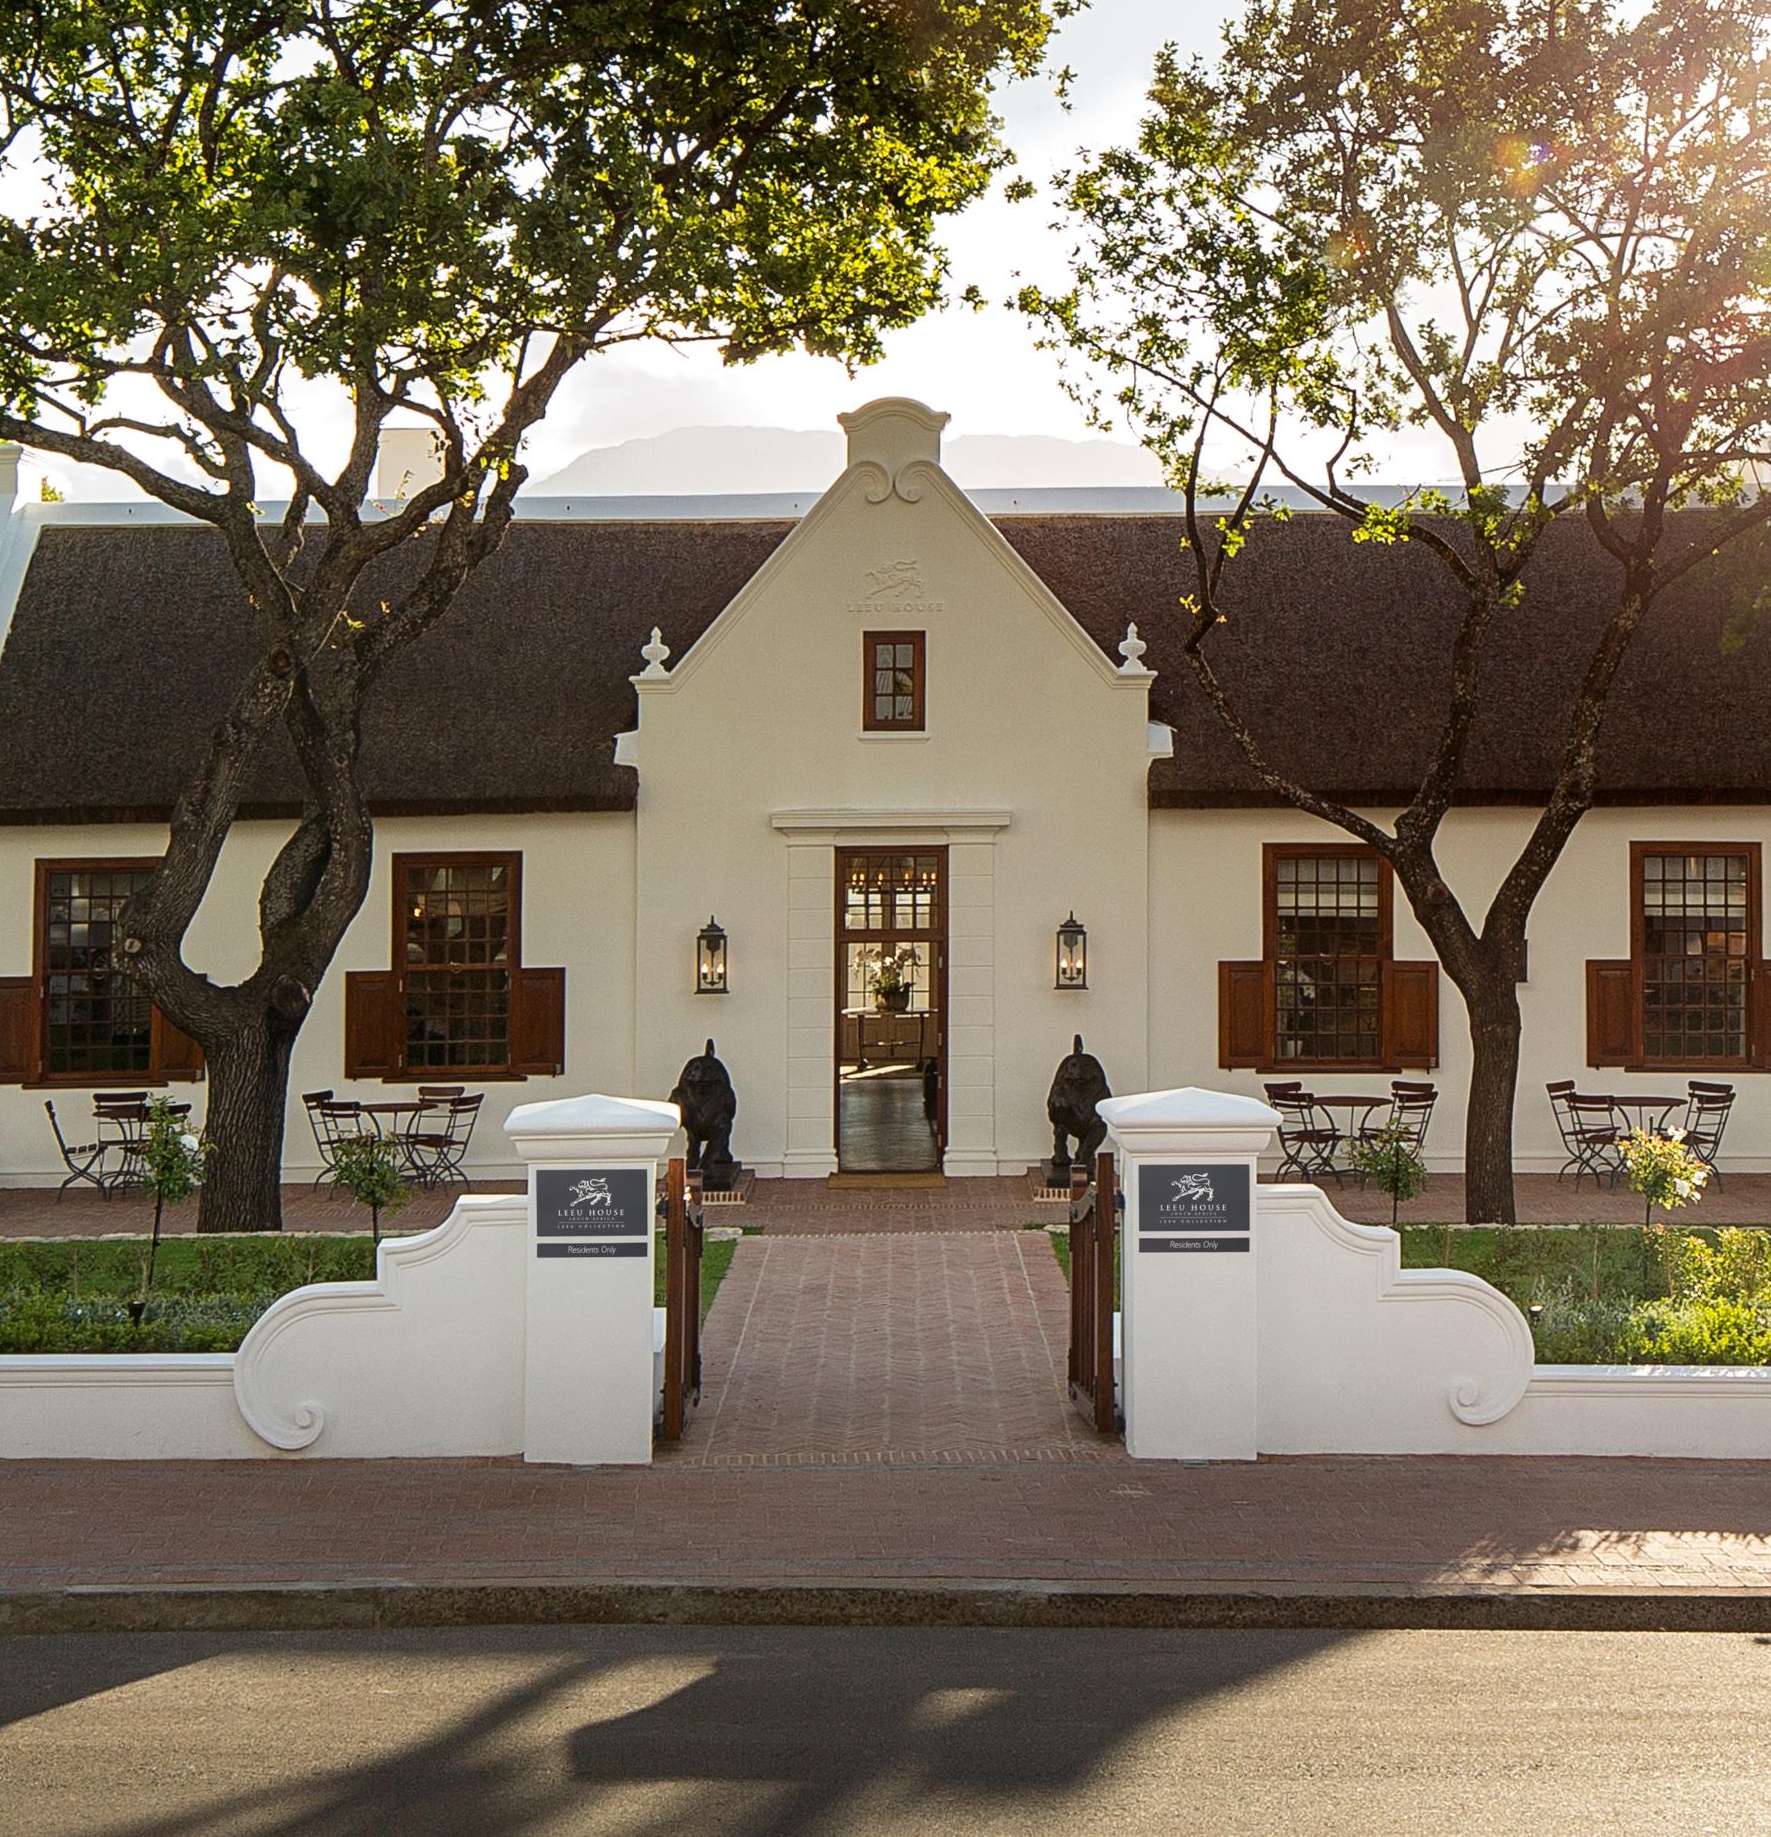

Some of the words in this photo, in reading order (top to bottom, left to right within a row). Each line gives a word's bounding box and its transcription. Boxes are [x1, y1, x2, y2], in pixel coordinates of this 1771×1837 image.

[892, 602, 943, 613] HOUSE
[568, 1245, 599, 1253] Residents
[601, 1245, 616, 1255] Only
[1170, 1240, 1201, 1249] Residents
[1203, 1240, 1218, 1250] Only
